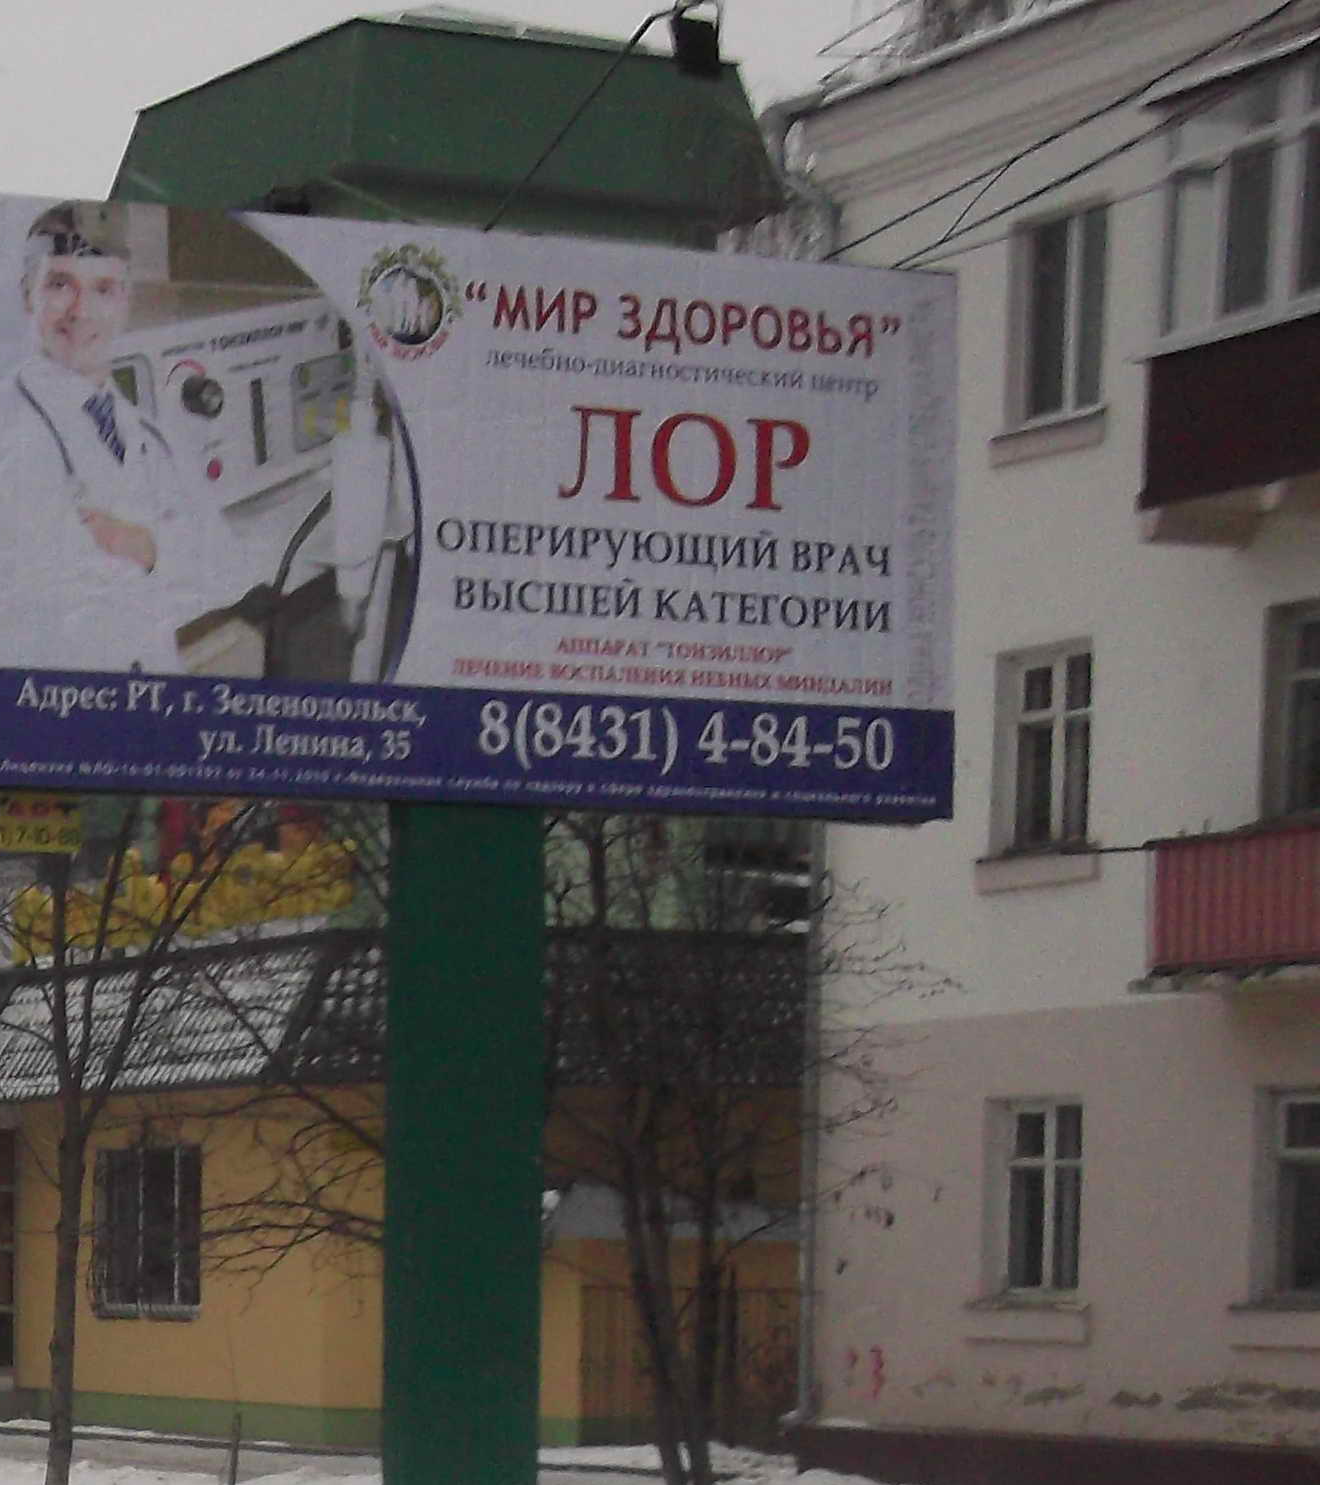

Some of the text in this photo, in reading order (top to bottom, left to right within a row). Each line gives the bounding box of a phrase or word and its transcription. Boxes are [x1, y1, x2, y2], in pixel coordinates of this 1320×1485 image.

[557, 405, 811, 511] ЛОР
[436, 517, 892, 576] ОПЕРИРУЮЩИЙ ВРАЧ
[453, 576, 891, 633] ВЫСШЕЙ КАТЕГОРИИ
[16, 677, 427, 727] Адрес: РТ, г. Зеленодольск,
[199, 724, 411, 764] ул. Ленина, 35
[479, 699, 894, 775] 8(8431) 4-84-50
